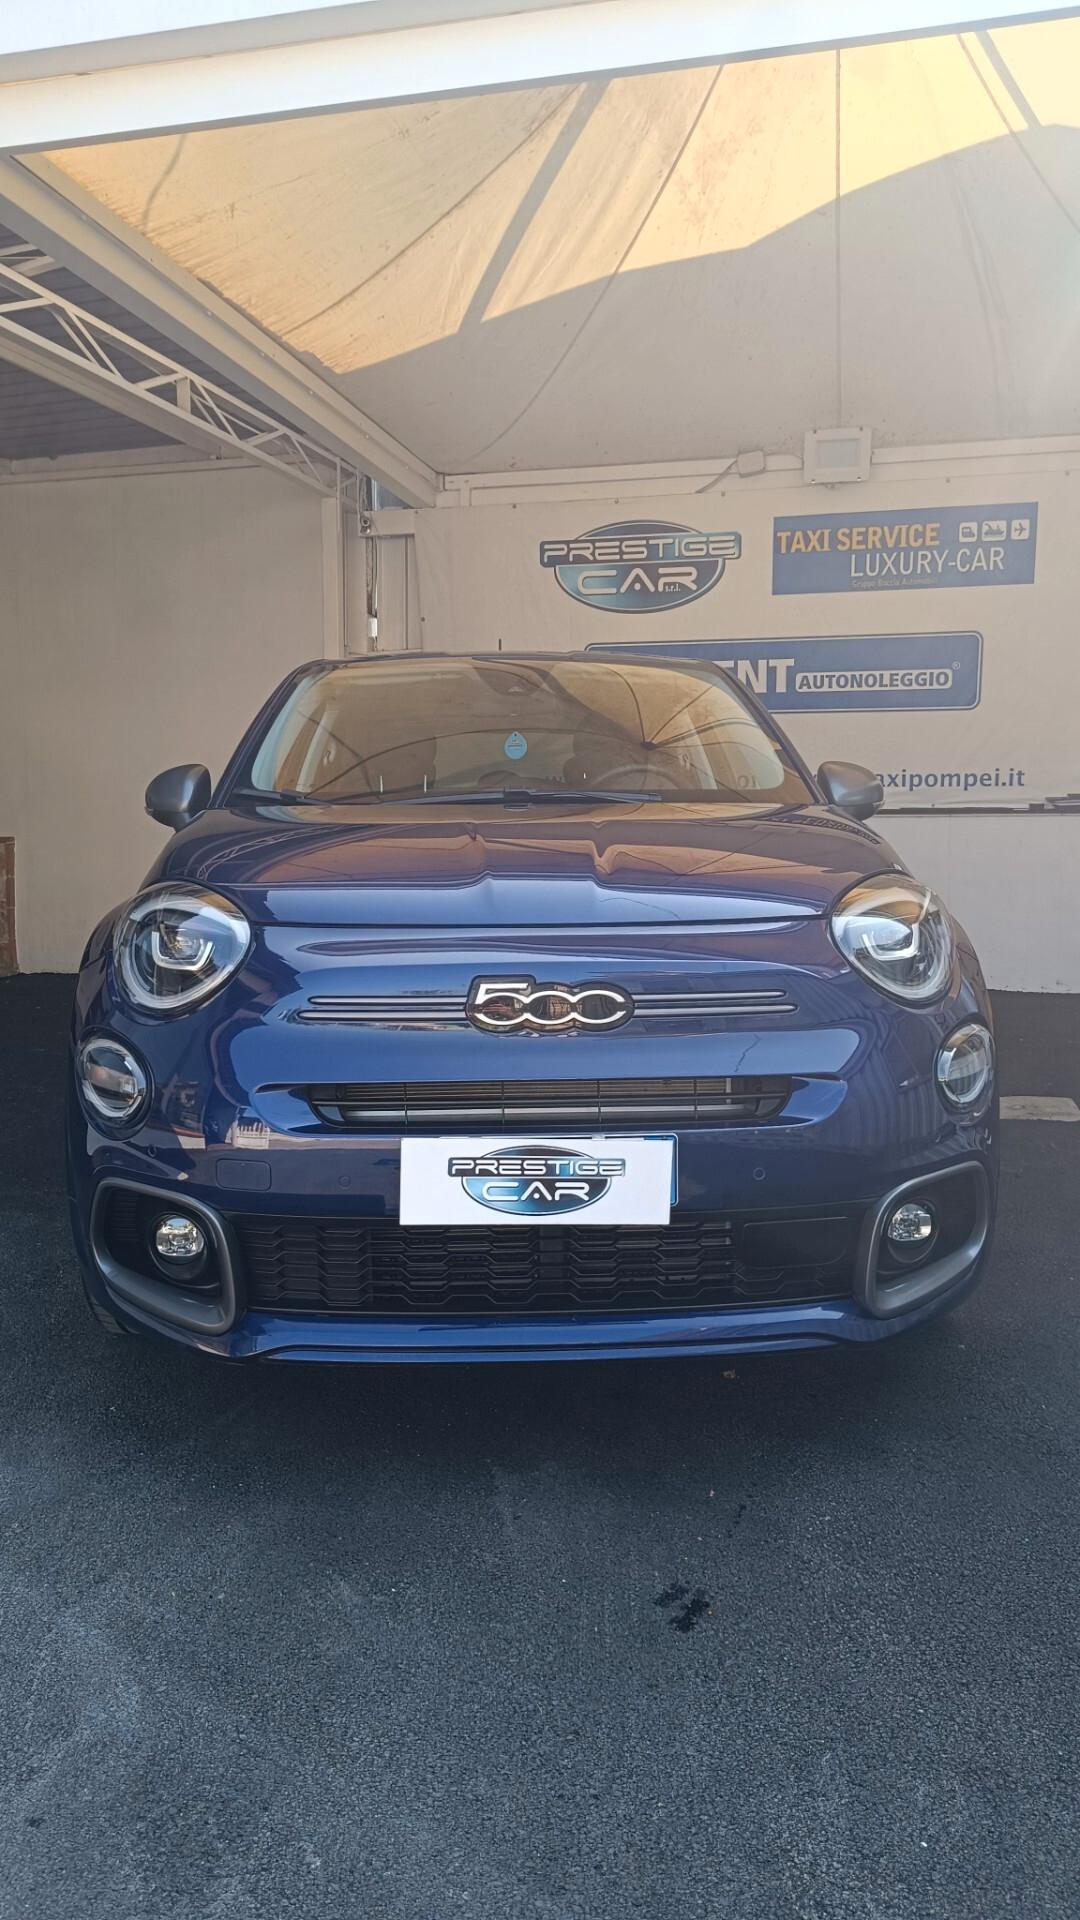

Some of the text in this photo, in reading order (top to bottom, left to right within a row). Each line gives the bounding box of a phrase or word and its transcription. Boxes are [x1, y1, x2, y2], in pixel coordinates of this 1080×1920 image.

[543, 535, 737, 563] PRESTIGE
[777, 523, 940, 554] TAXI SERVICE
[851, 547, 1005, 577] LUXURY-CAR
[577, 566, 698, 595] CAR
[798, 671, 950, 690] AUTONOLEGGIO
[474, 983, 627, 1025] 500
[451, 1159, 625, 1176] PRESTIGE
[482, 1181, 590, 1201] CAR
